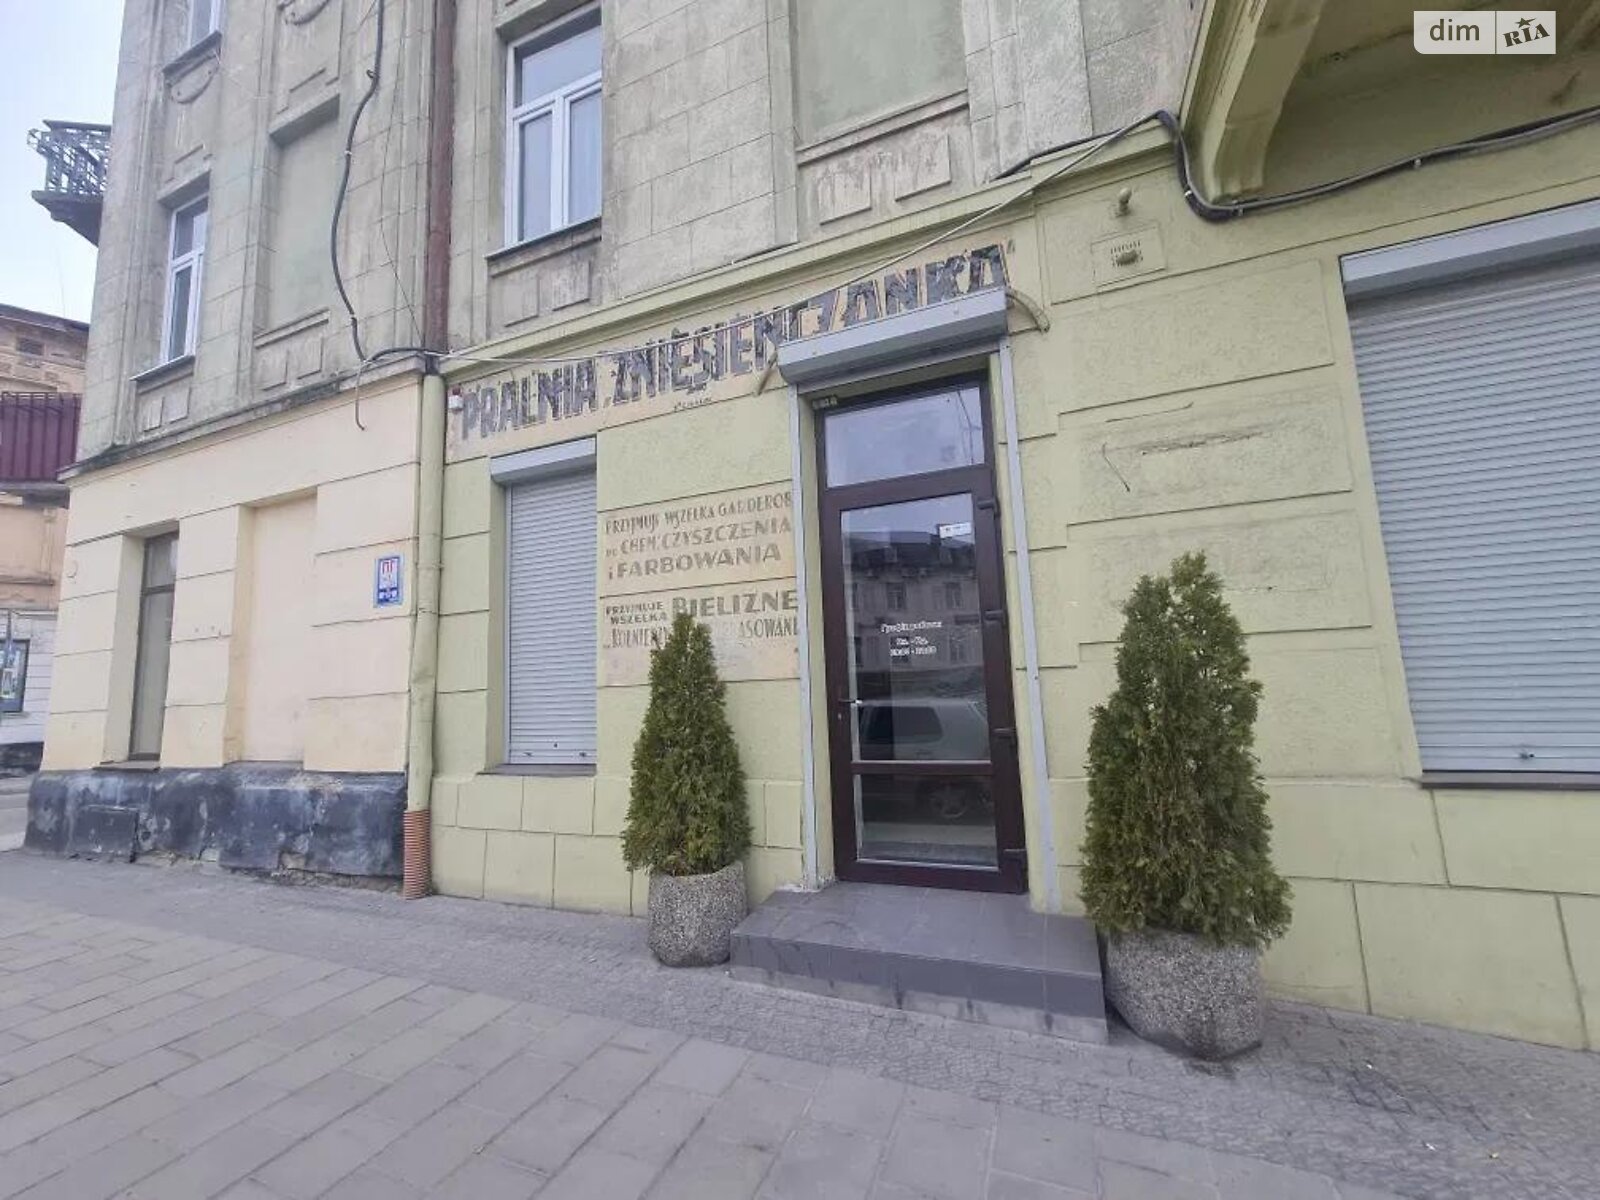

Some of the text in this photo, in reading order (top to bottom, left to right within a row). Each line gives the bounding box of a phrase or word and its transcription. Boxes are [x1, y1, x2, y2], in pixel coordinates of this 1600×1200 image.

[462, 359, 597, 440] PRALNIA
[662, 517, 792, 548] CZYSZCZENIA
[617, 543, 781, 577] FARBOWANIA
